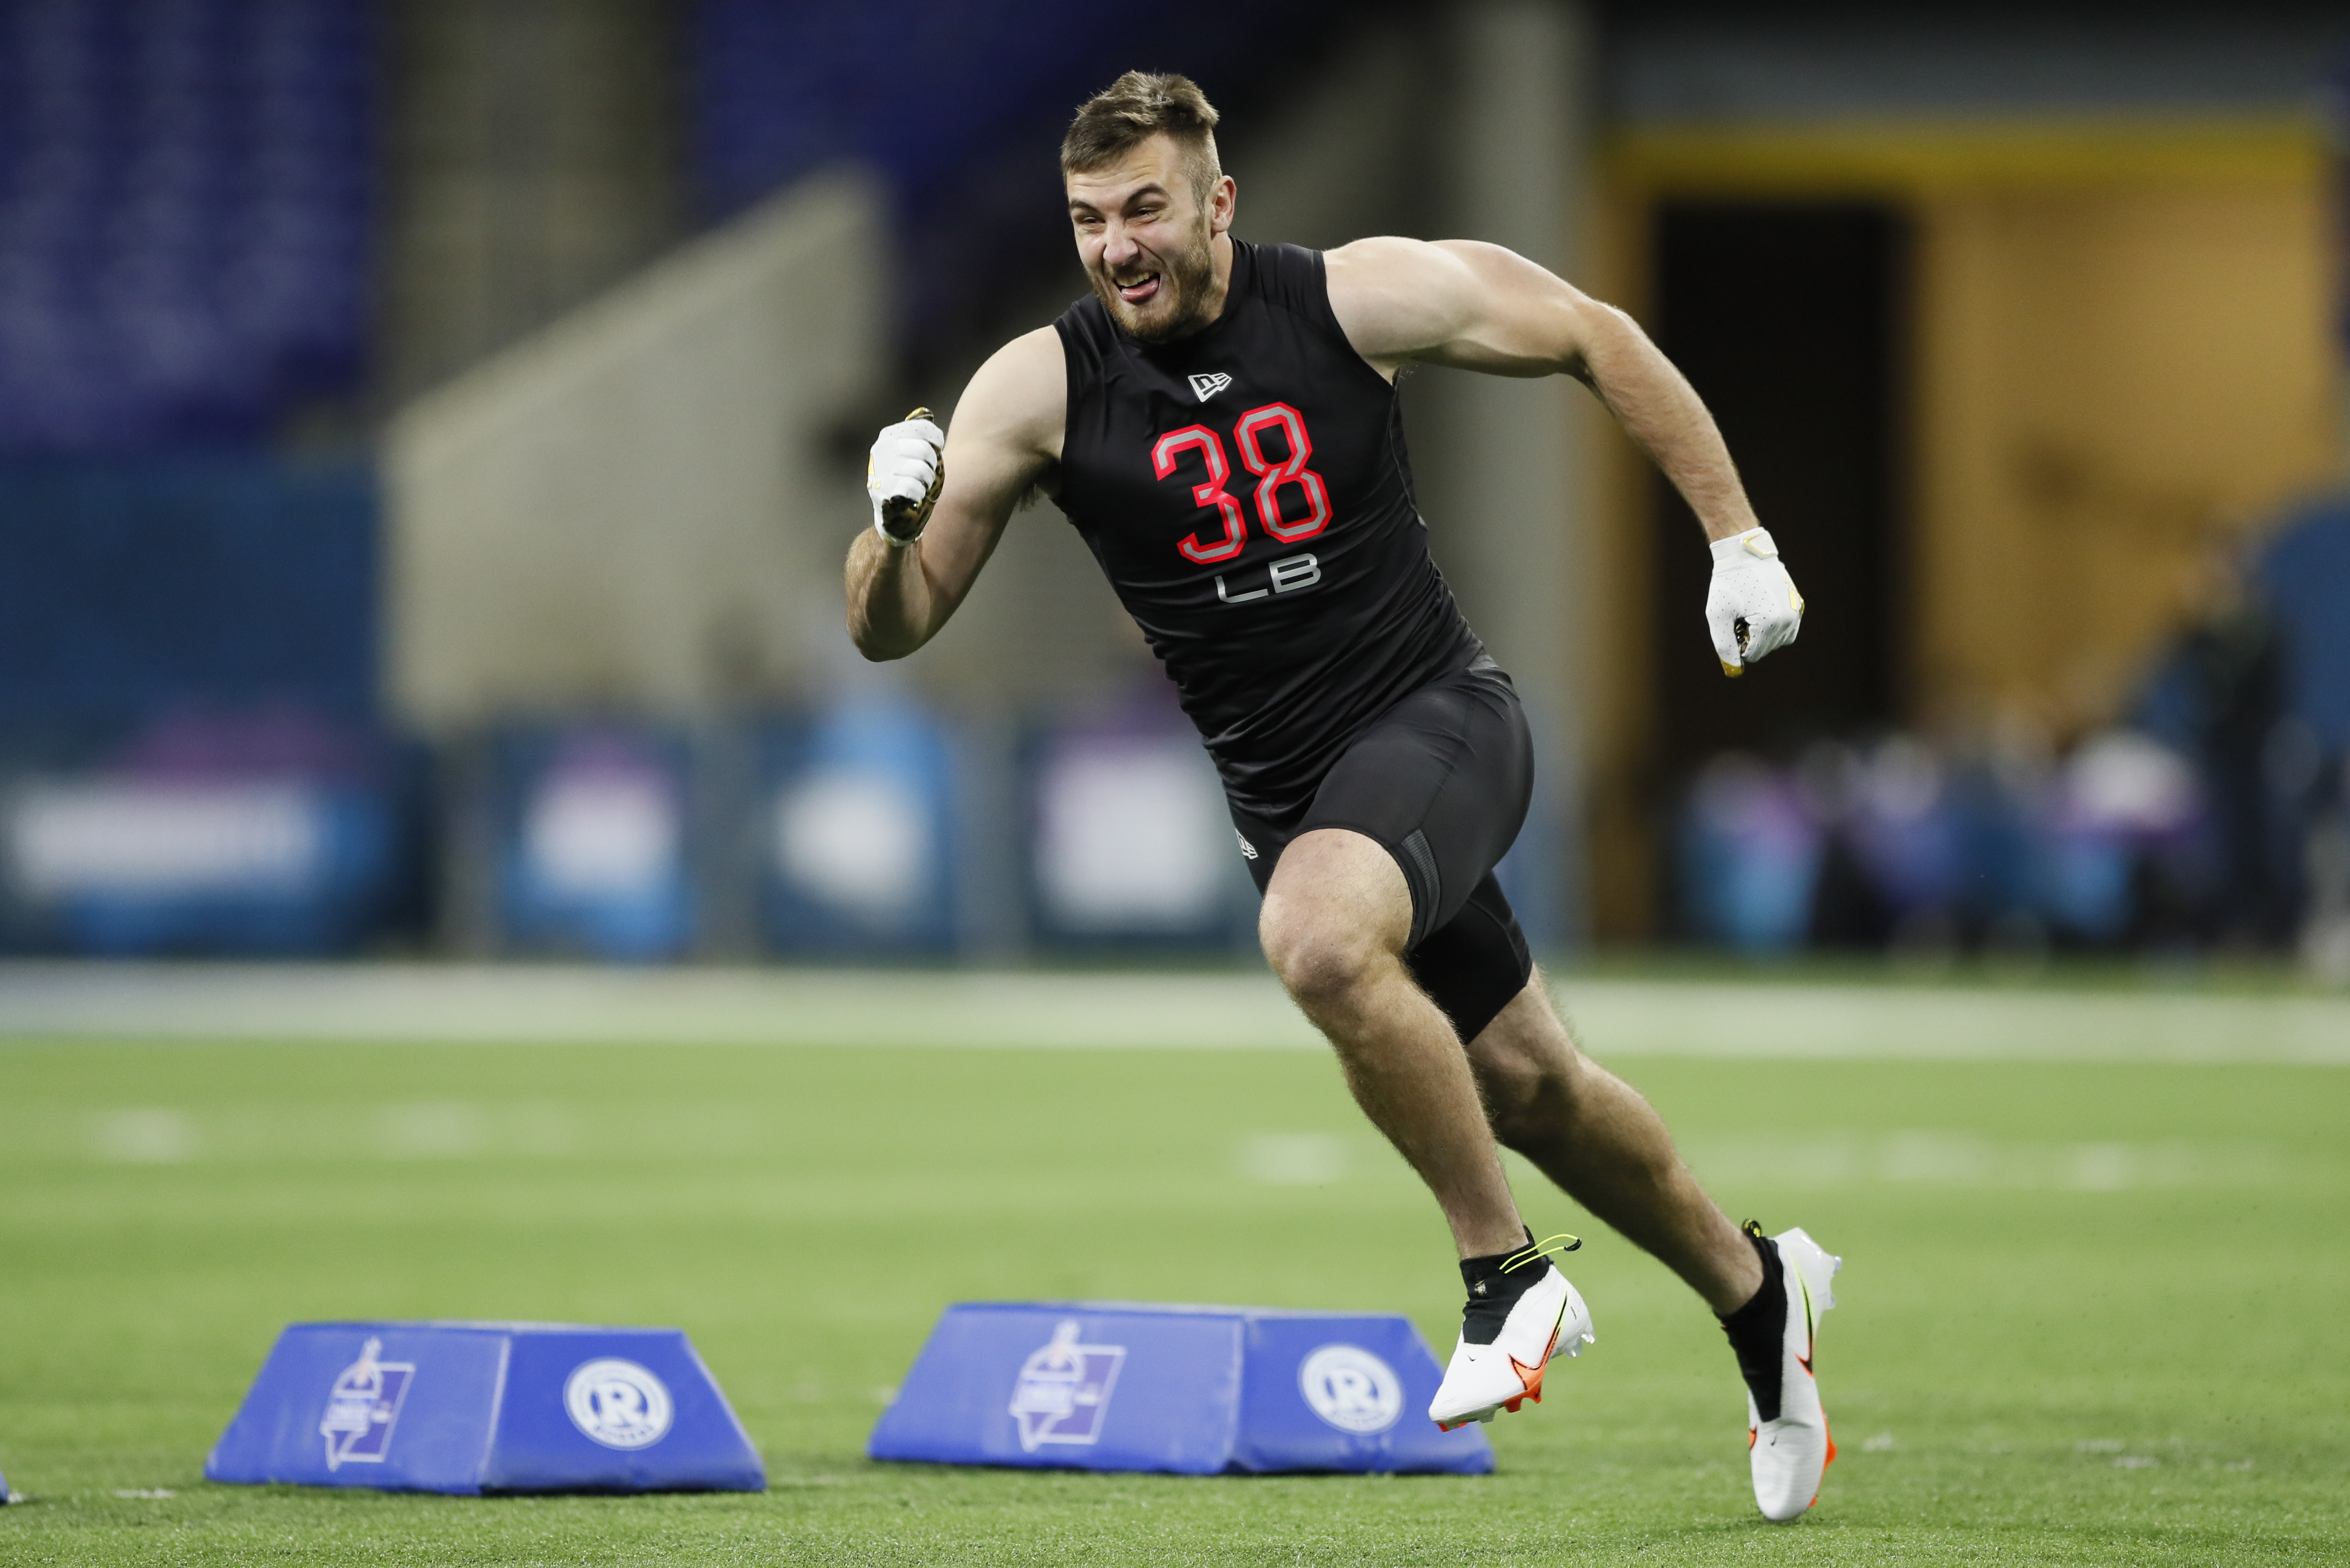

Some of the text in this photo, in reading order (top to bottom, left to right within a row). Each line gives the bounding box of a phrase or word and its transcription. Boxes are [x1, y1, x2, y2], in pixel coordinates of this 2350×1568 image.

[1151, 401, 1333, 564] 38
[1215, 553, 1321, 603] LB
[592, 1382, 647, 1426] R
[1325, 1369, 1378, 1411] R
